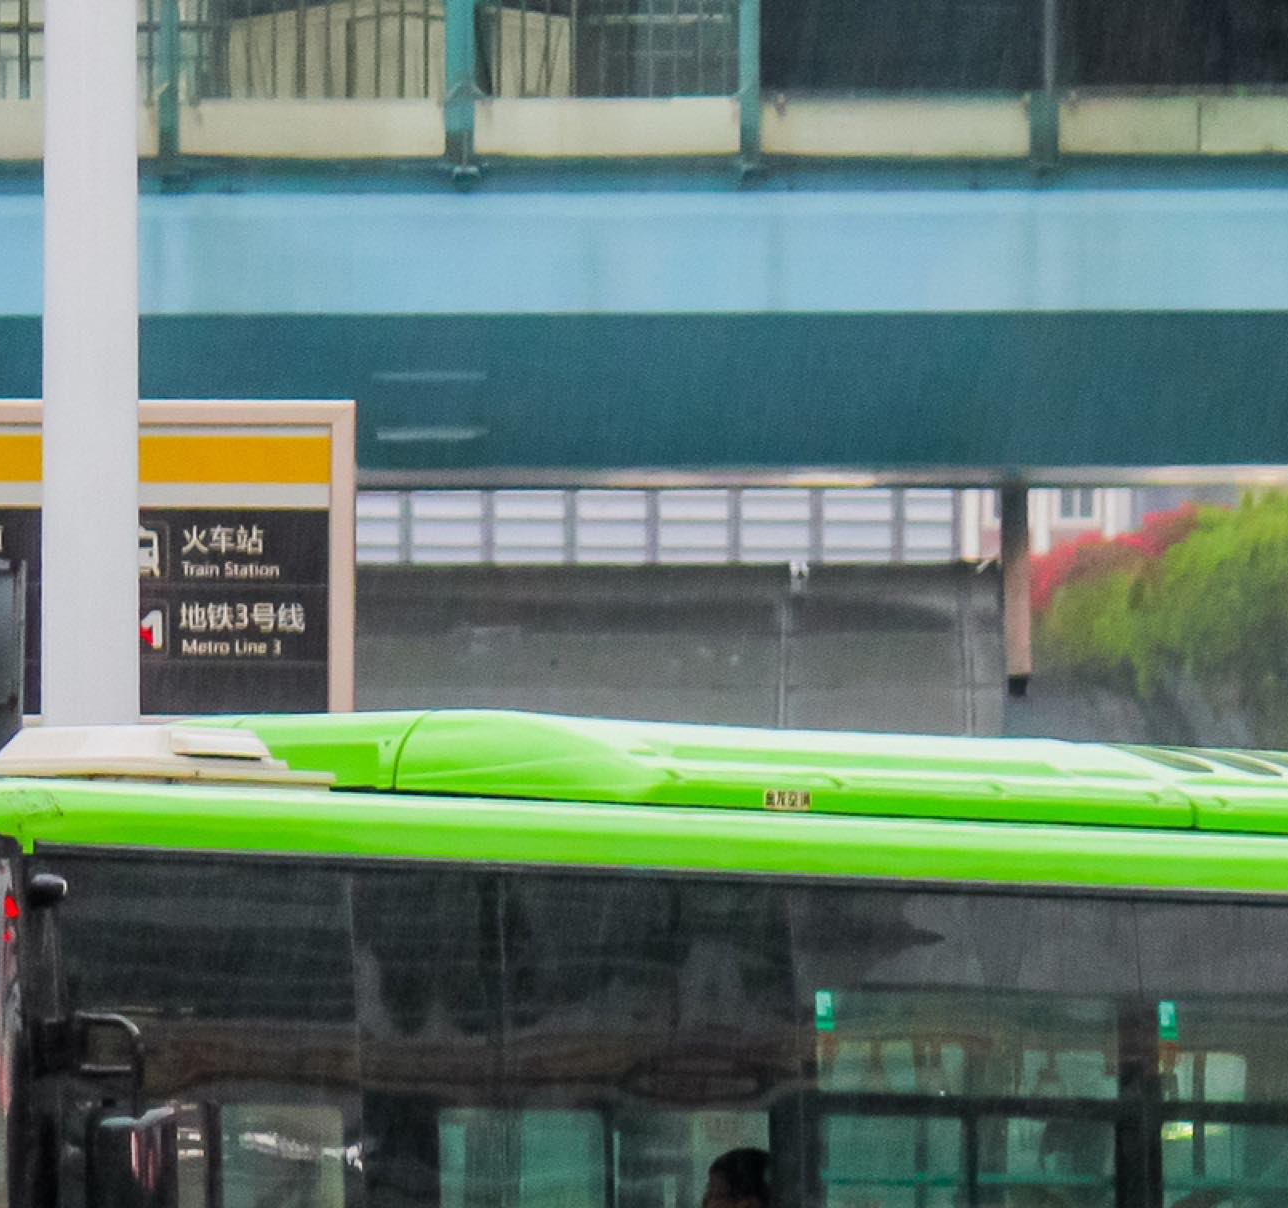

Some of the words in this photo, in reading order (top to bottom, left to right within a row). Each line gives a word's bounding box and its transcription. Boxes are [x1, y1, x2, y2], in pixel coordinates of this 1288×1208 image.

[181, 523, 264, 555] 火车站
[182, 561, 220, 578] Train
[224, 561, 281, 578] Station
[179, 601, 306, 632] 地铁3号线
[181, 639, 231, 656] Metro
[235, 639, 268, 655] Line
[273, 639, 283, 656] 3
